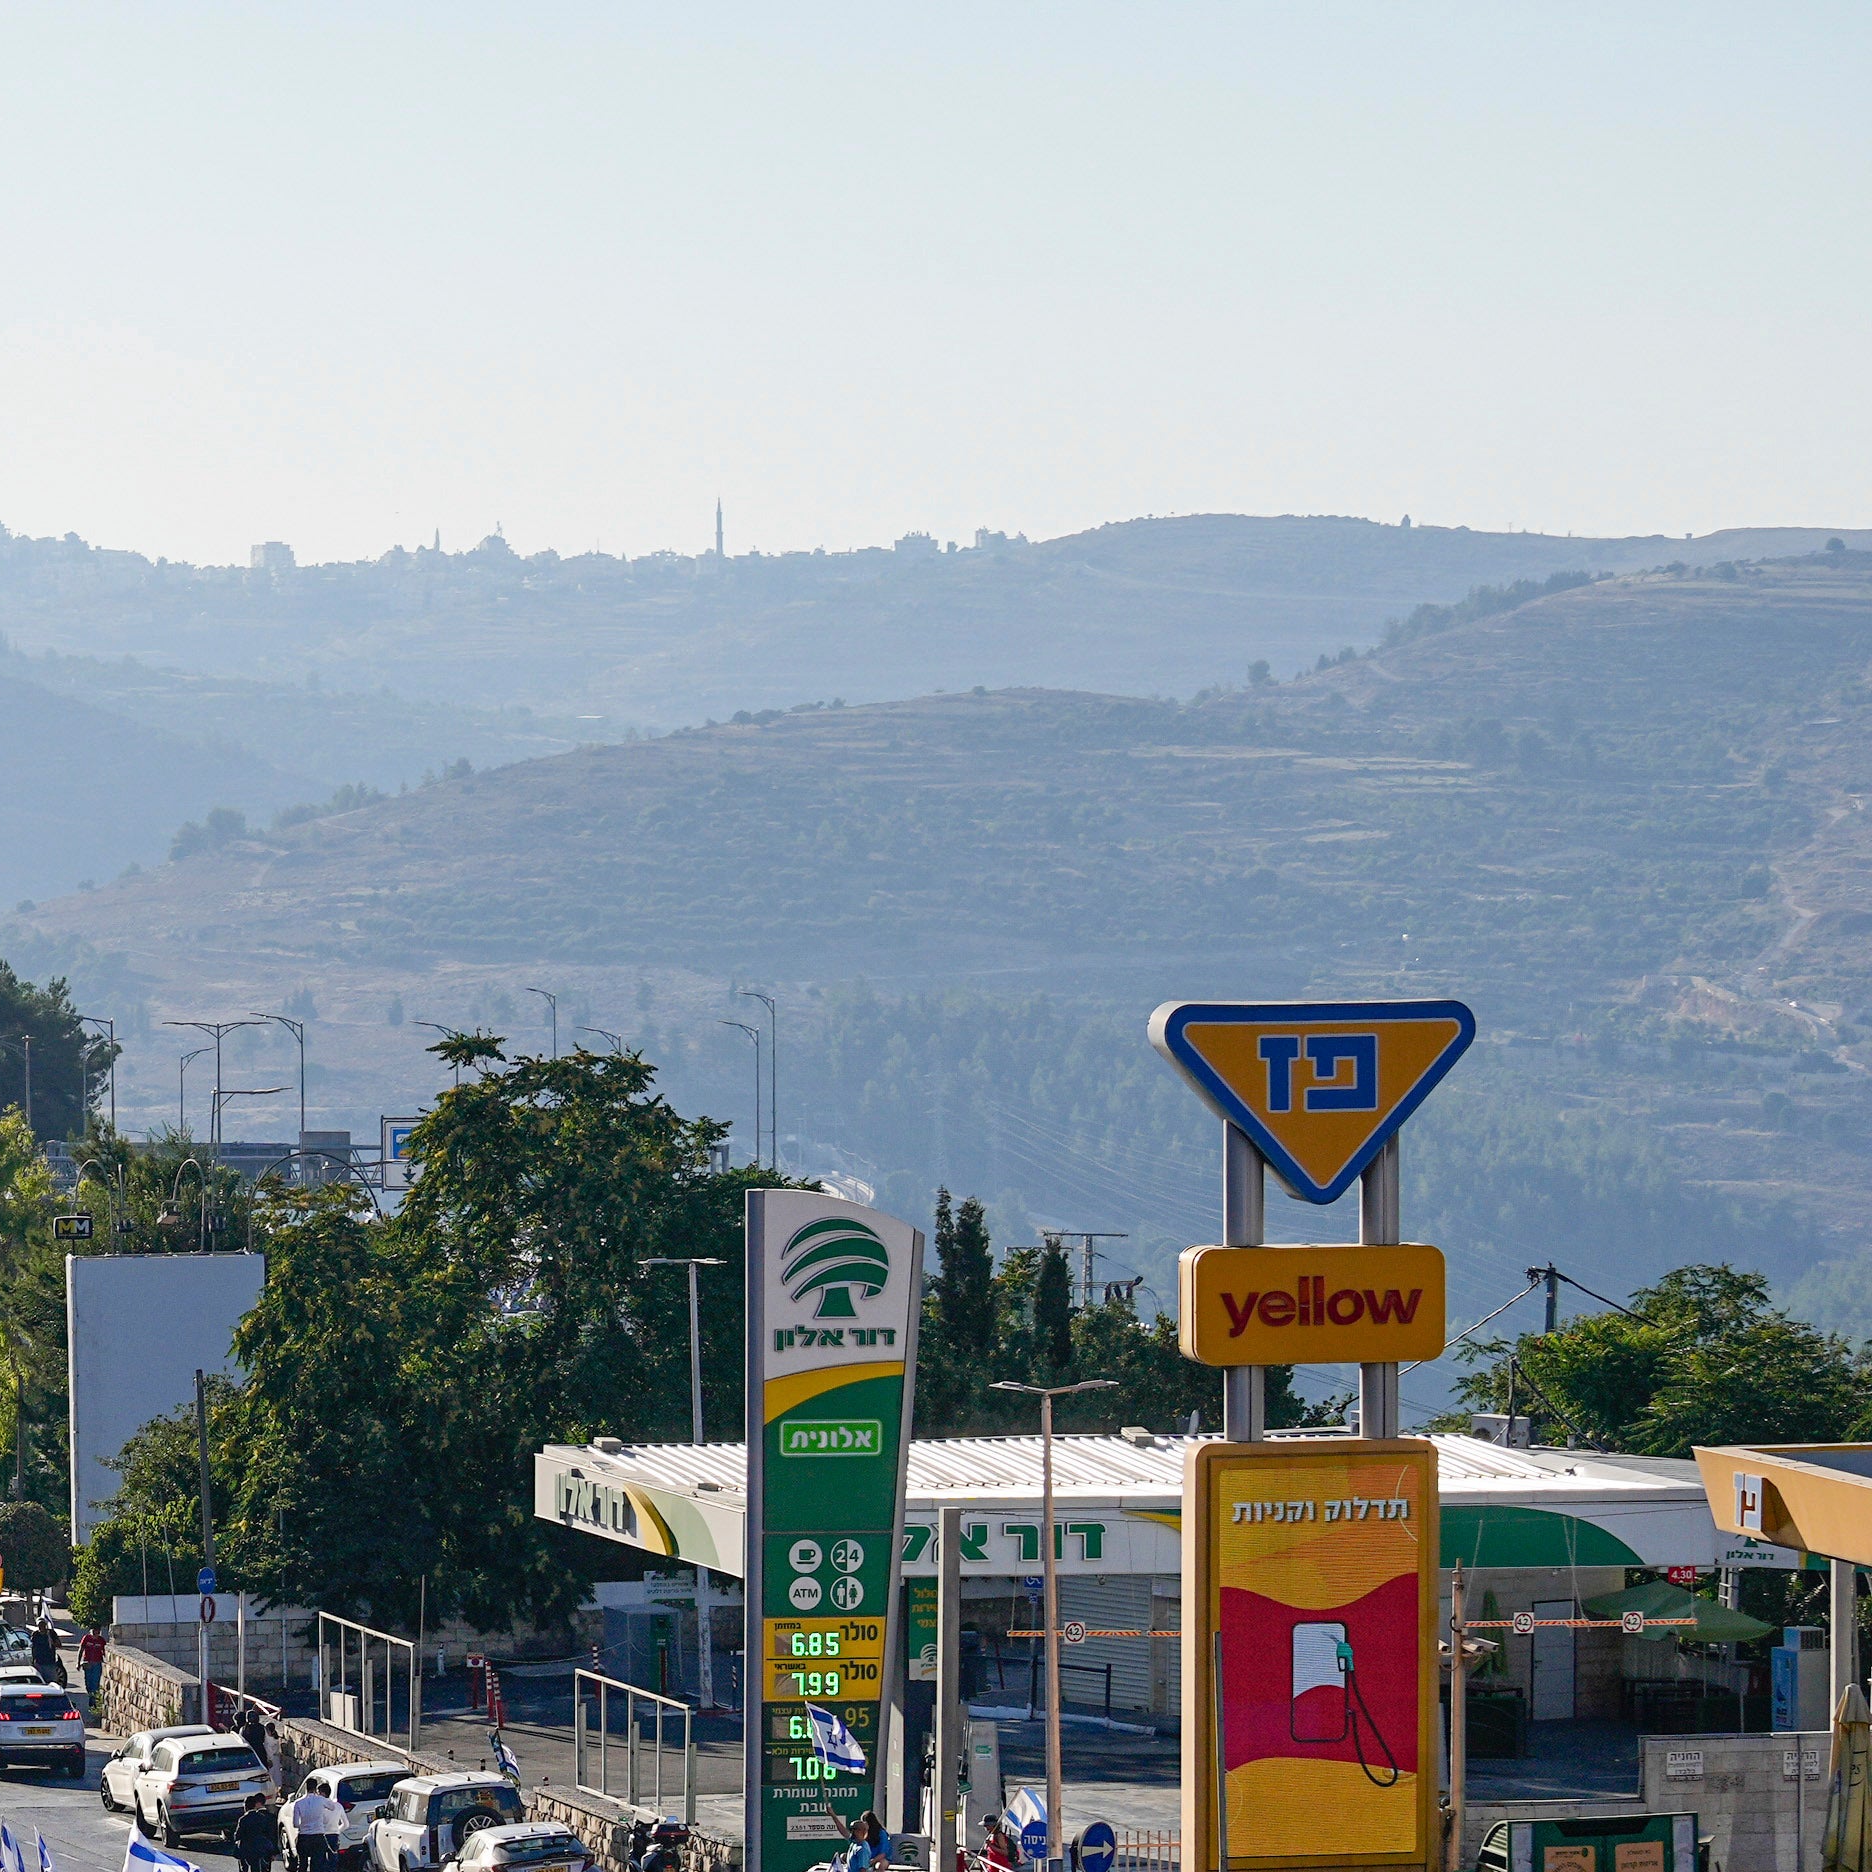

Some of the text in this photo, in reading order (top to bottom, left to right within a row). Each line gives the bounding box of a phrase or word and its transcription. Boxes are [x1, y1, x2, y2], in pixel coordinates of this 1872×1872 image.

[1258, 1033, 1378, 1113] פז
[1221, 1275, 1423, 1338] yellow
[774, 1325, 897, 1352] דור אלון
[790, 1428, 872, 1450] אלונית
[1232, 1496, 1409, 1523] תדלוק וקניות
[1003, 1521, 1107, 1563] דור
[836, 1549, 860, 1563] 24
[1758, 1552, 1775, 1561] דור
[1671, 1571, 1693, 1580] 4.30
[793, 1588, 819, 1598] ATM
[840, 1621, 878, 1641] סולר
[791, 1632, 840, 1657] 6.85
[839, 1661, 878, 1681] סולר
[791, 1671, 840, 1696] 7.99
[845, 1707, 870, 1728] 95
[773, 1788, 818, 1799] שומרת
[1024, 1834, 1047, 1846] ניסה
